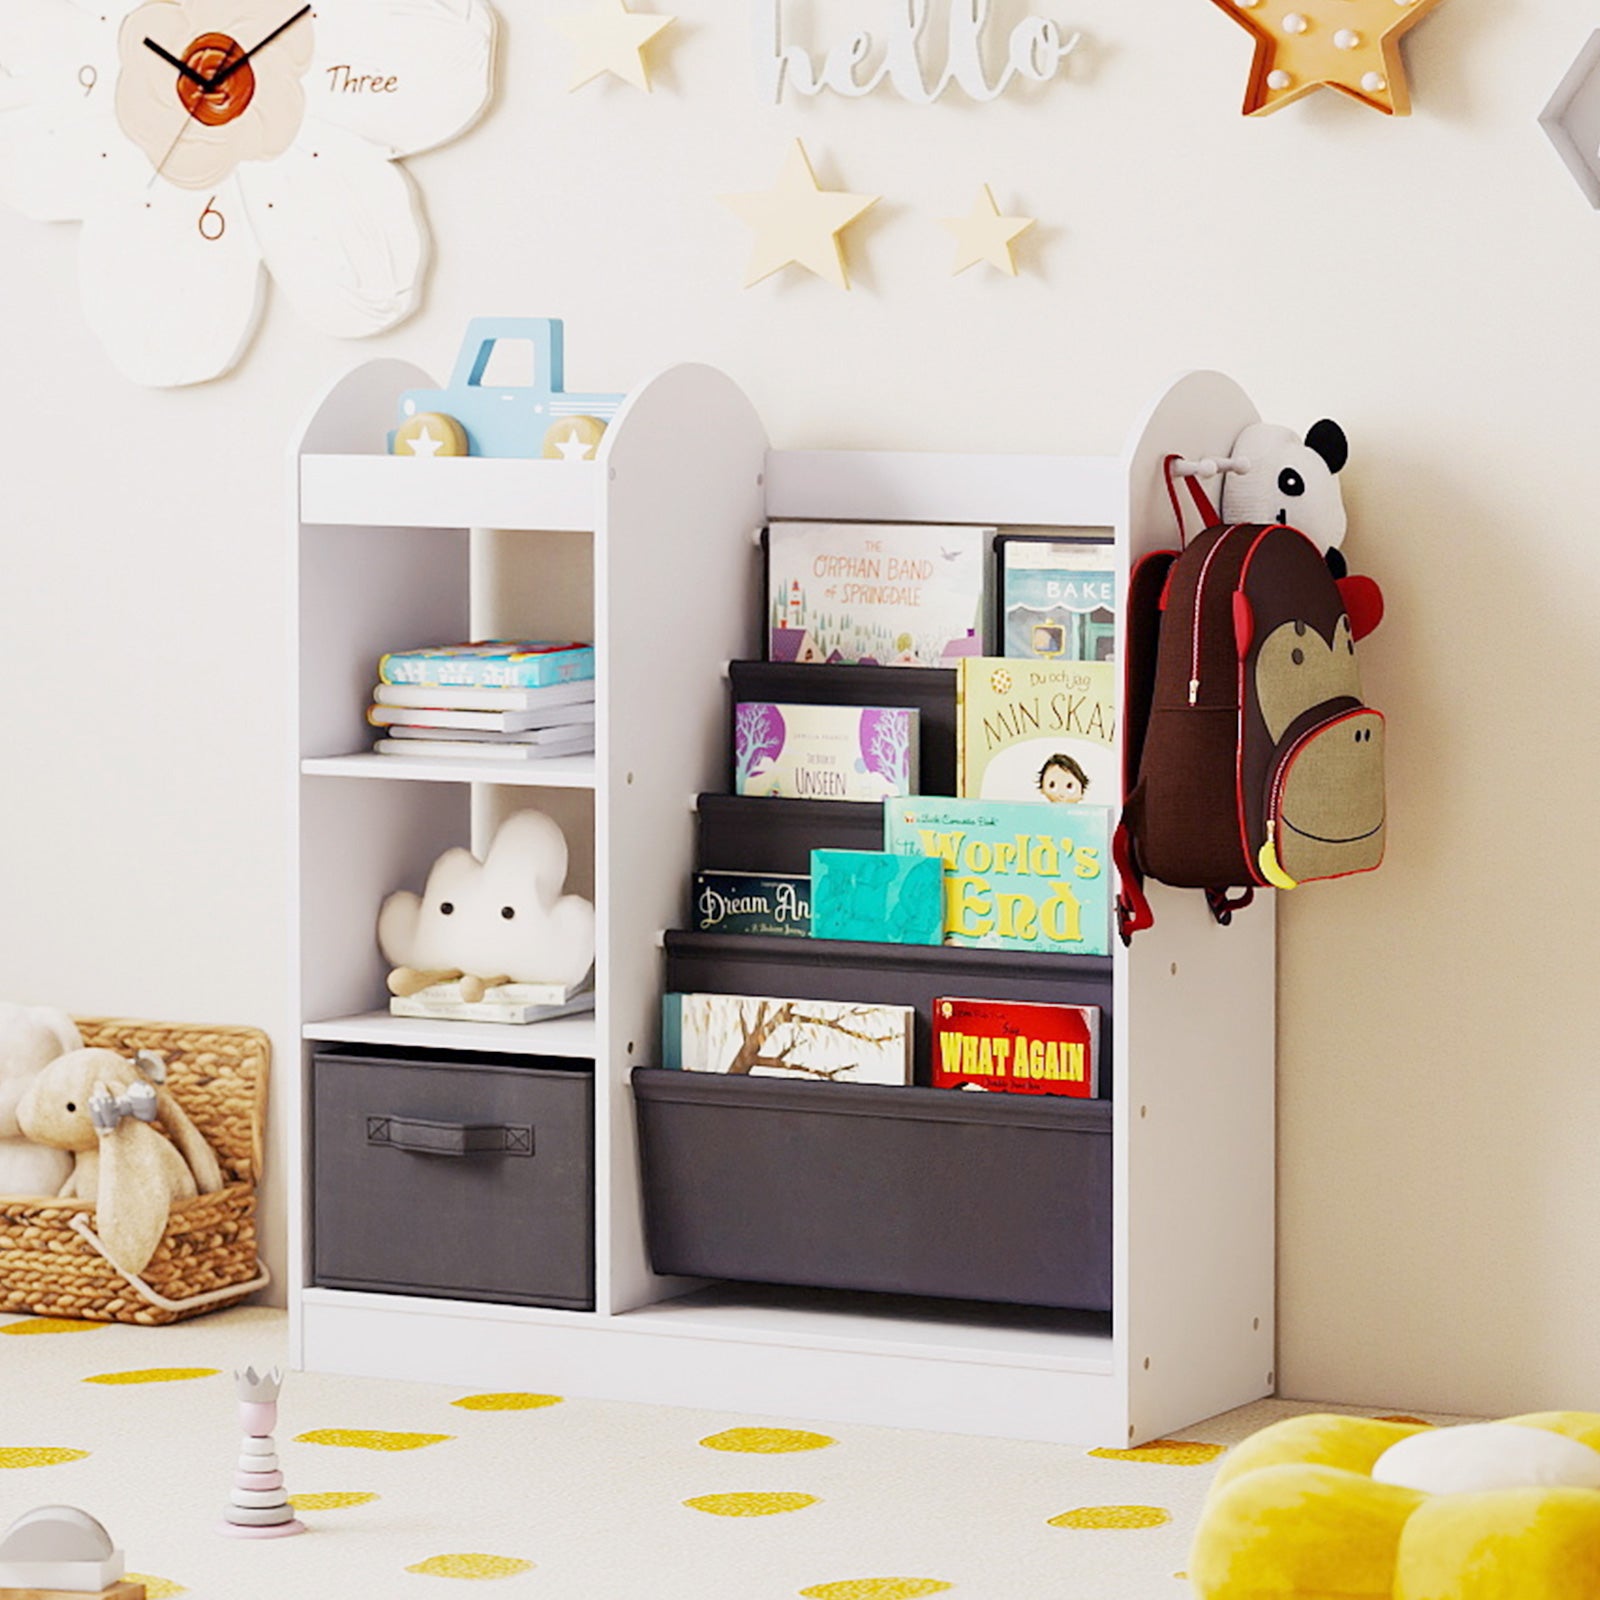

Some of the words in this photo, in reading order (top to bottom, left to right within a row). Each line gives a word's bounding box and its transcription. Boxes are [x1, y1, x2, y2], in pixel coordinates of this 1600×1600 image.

[752, 0, 1082, 104] hello
[78, 64, 98, 98] 9
[326, 64, 400, 95] Three
[198, 196, 226, 241] 6
[865, 540, 883, 553] THE
[813, 554, 881, 579] ORPHAN
[887, 557, 934, 581] BAND
[824, 585, 837, 600] of
[841, 583, 923, 607] SPRINGDALE
[1046, 580, 1112, 600] BAKE
[1030, 672, 1047, 687] Du
[1049, 670, 1069, 684] och
[1066, 674, 1092, 693] jag
[983, 697, 1041, 751] MIN
[795, 767, 847, 797] UNSEEN
[918, 829, 1102, 881] World's
[699, 886, 771, 930] Dream
[942, 875, 1084, 943] End
[939, 1031, 1010, 1077] WHAT
[1012, 1035, 1085, 1083] AGAIN
